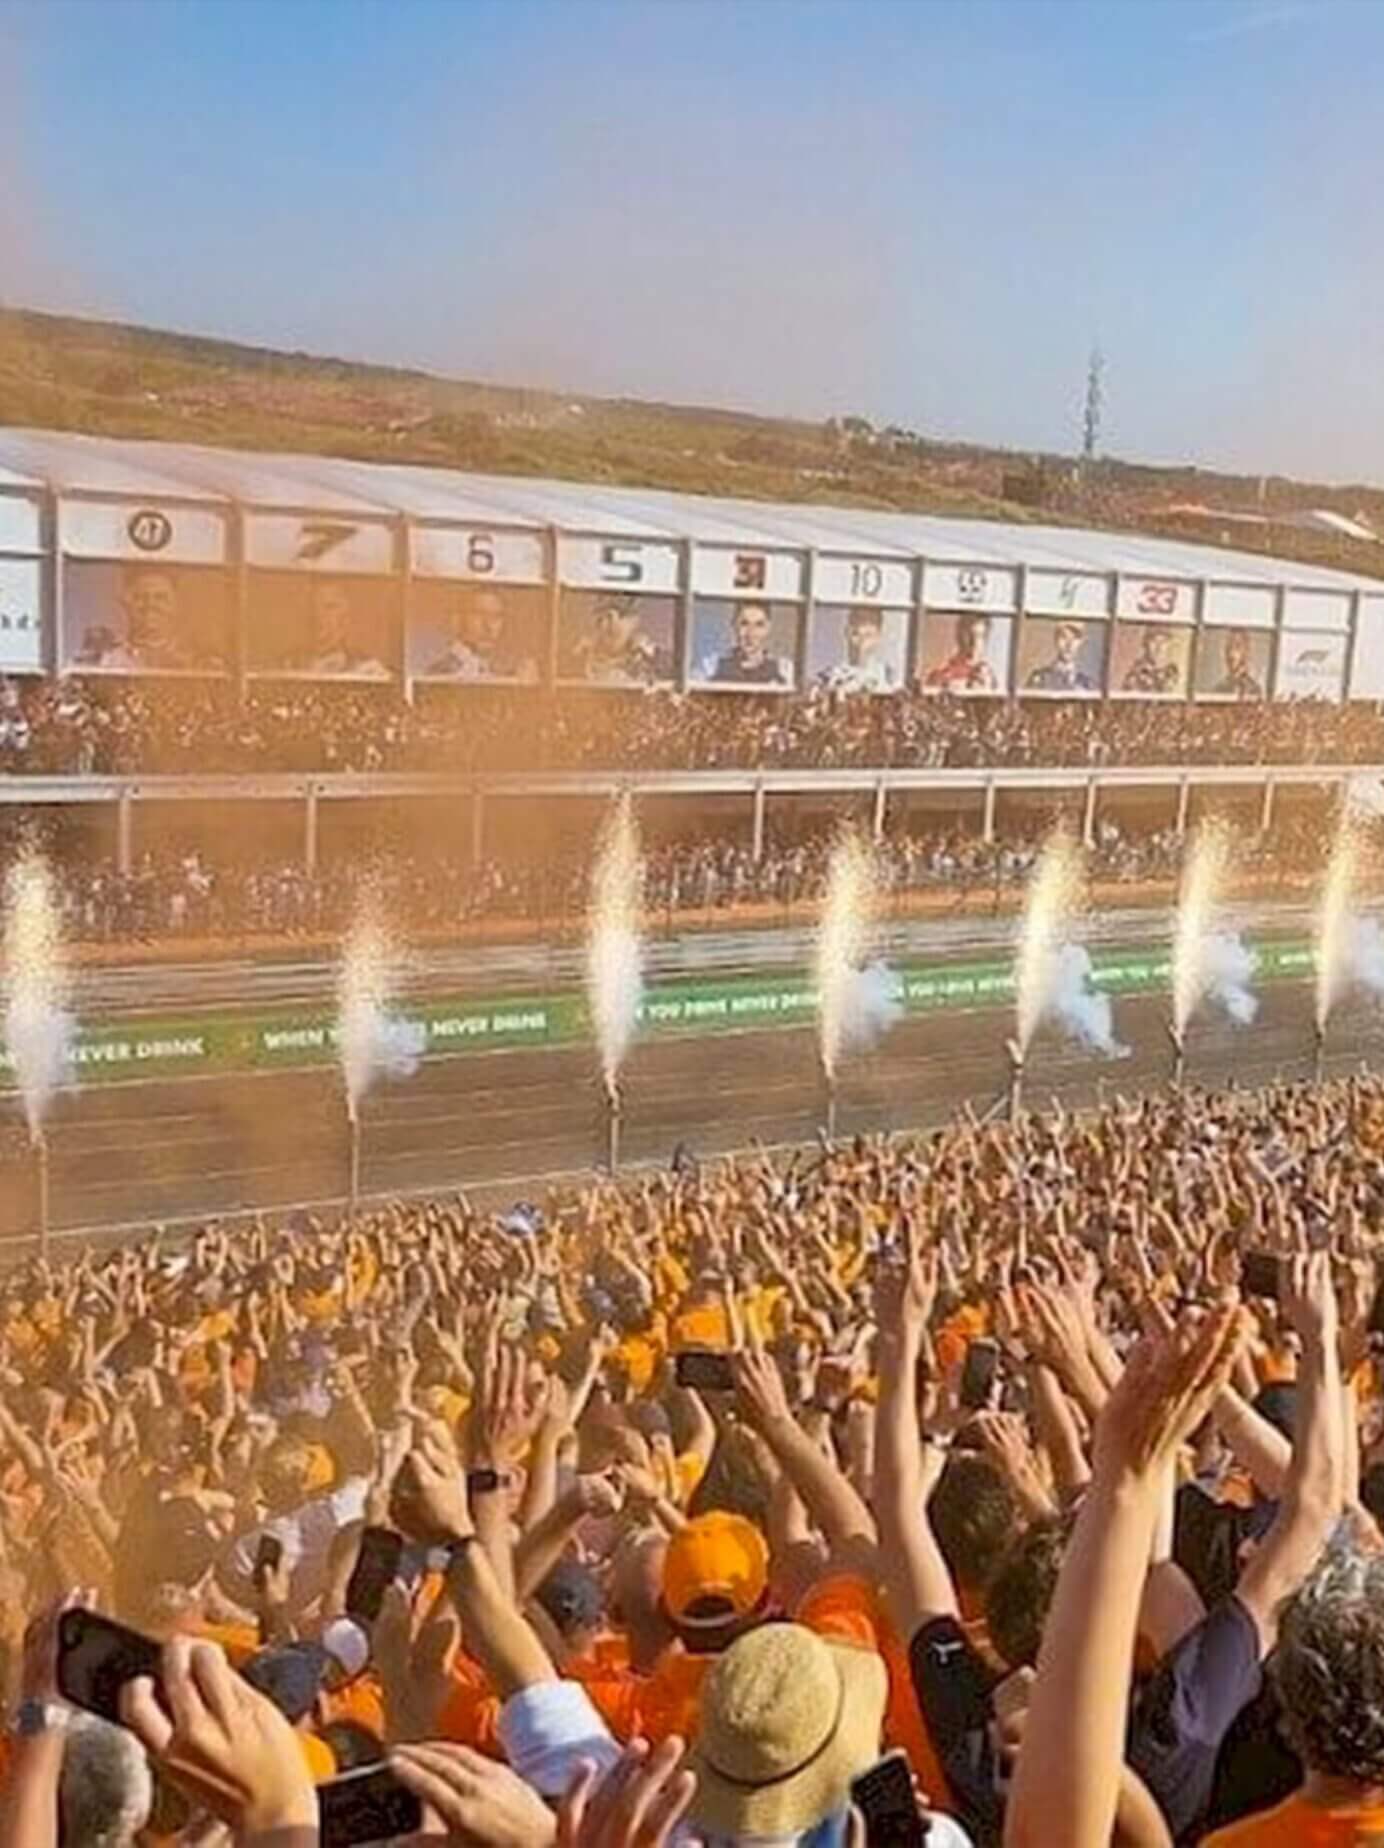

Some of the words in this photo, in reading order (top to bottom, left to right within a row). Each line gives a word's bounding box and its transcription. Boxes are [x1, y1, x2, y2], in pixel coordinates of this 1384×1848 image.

[467, 532, 495, 573] 6
[600, 545, 643, 582] 5
[851, 563, 883, 596] 10
[1137, 583, 1179, 614] 33
[136, 1036, 204, 1059] DRINK
[263, 1029, 324, 1049] WHEN
[431, 1016, 488, 1036] NEVER
[493, 1011, 547, 1032] DRINK
